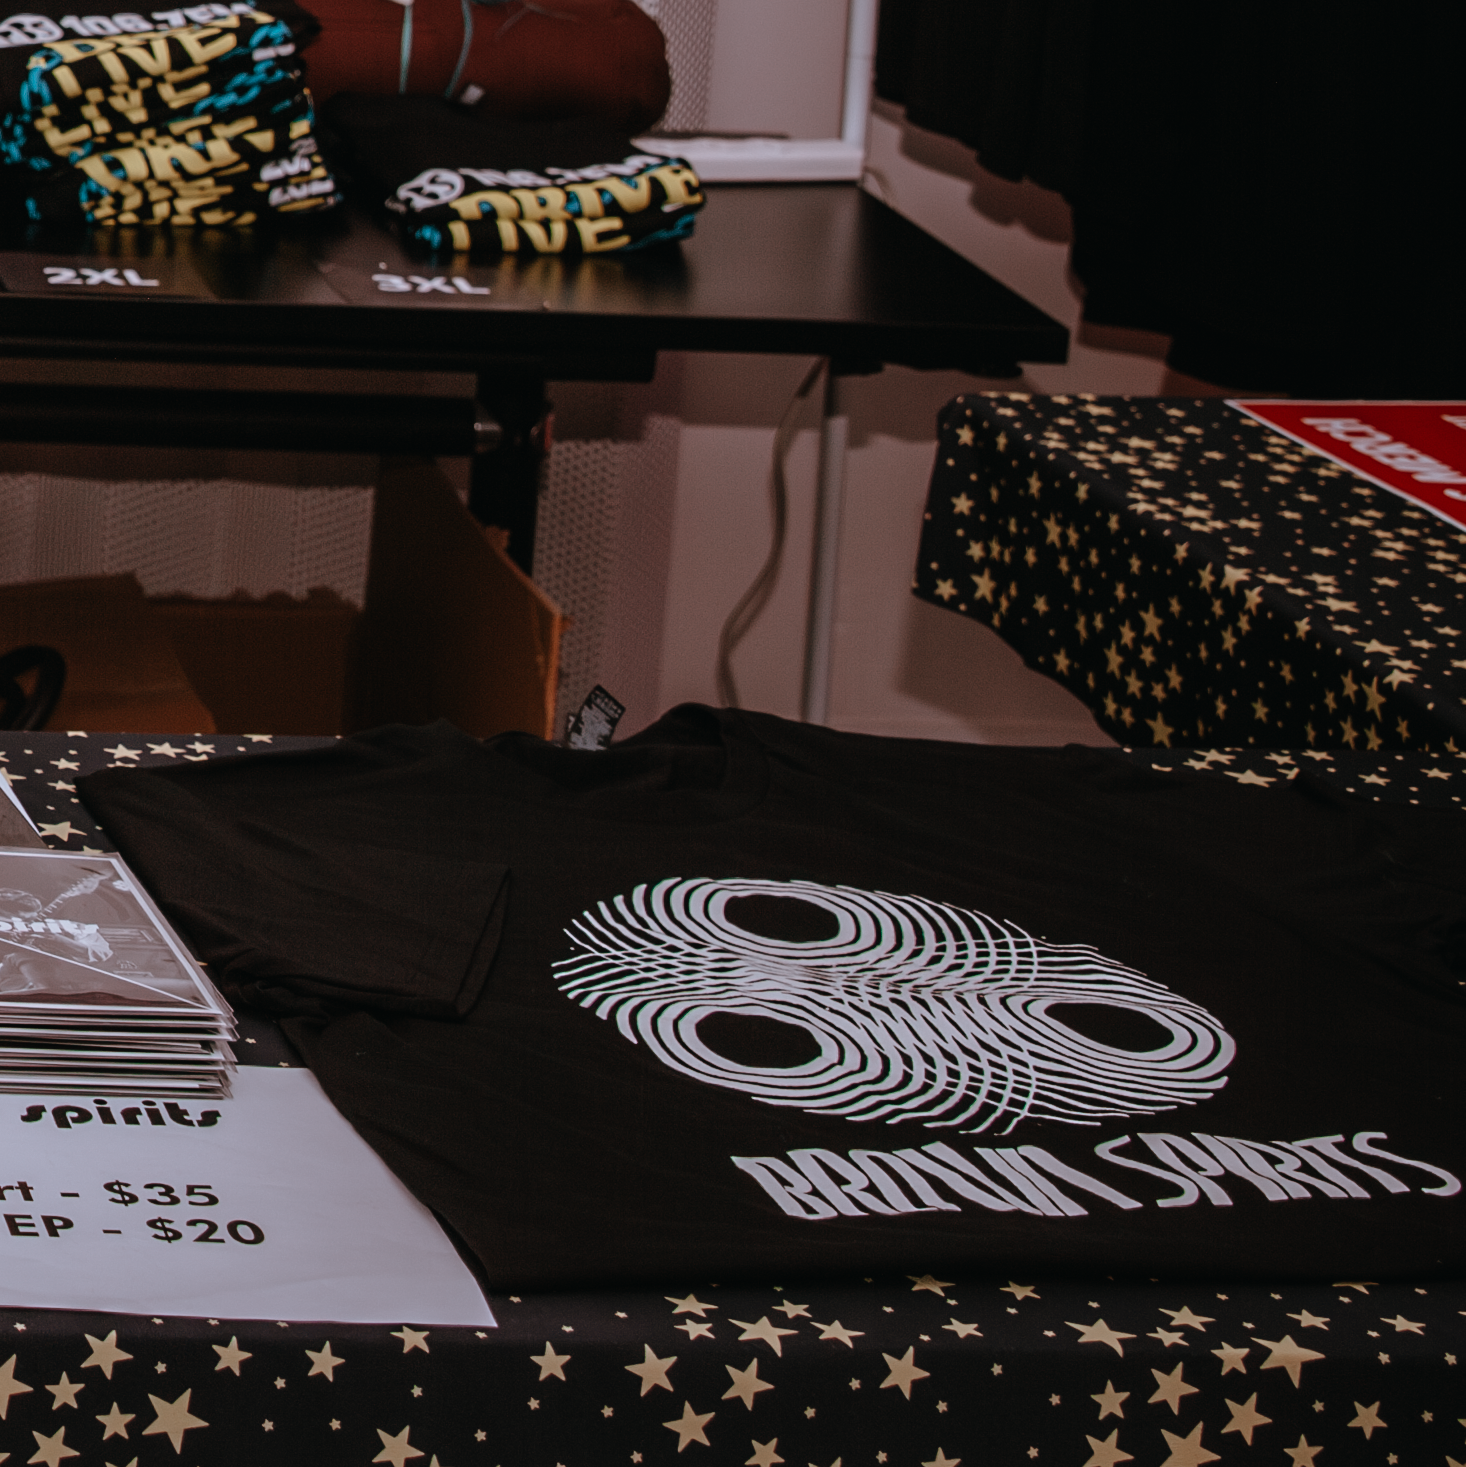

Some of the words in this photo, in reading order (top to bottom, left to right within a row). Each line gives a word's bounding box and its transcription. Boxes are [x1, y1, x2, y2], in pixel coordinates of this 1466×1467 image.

[42, 266, 161, 287] 2XL
[371, 273, 492, 296] 3XL
[20, 1096, 221, 1129] spirits
[103, 1177, 220, 1210] $35
[6, 1213, 75, 1239] EP
[150, 1215, 266, 1247] $20
